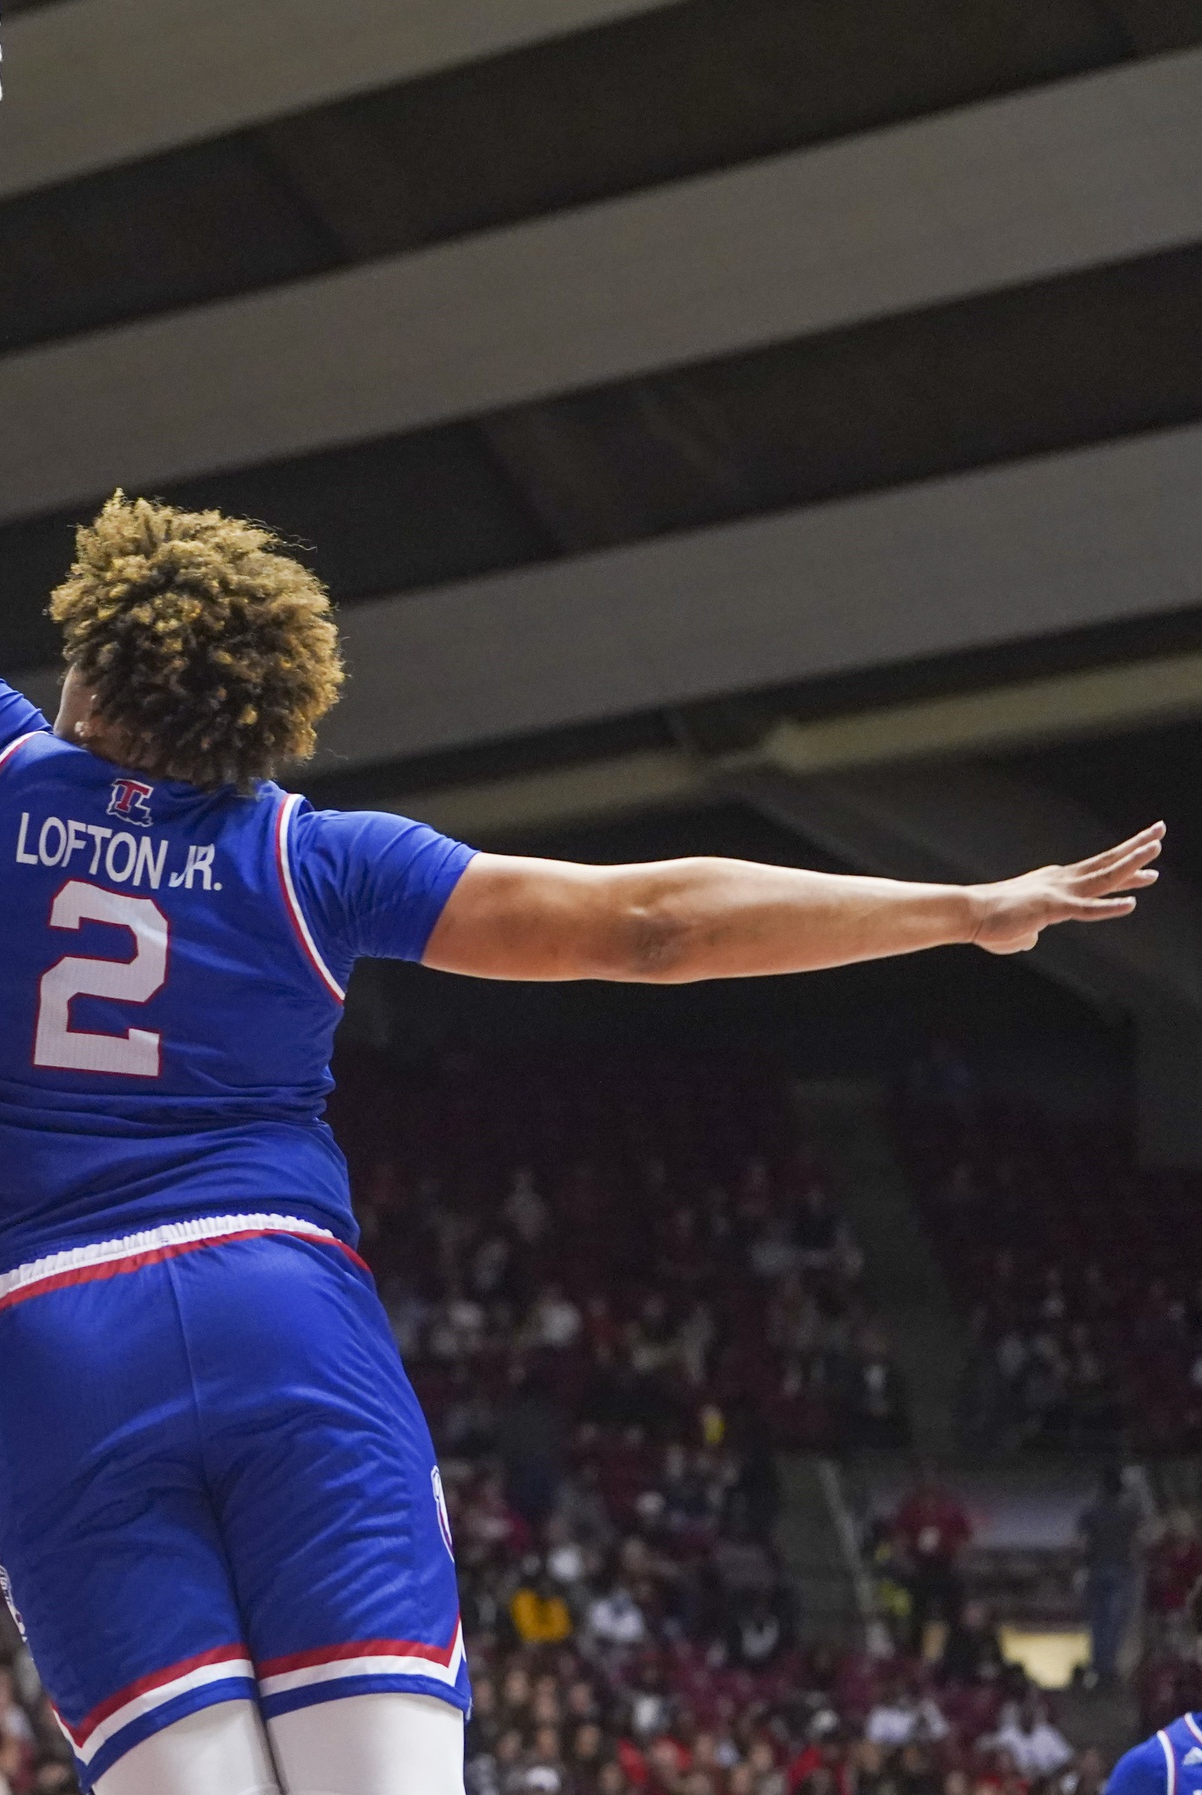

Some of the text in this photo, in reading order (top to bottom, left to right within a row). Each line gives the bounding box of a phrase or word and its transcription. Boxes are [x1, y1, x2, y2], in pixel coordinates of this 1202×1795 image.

[16, 812, 222, 891] LOFTON JR.
[32, 879, 170, 1077] 2
